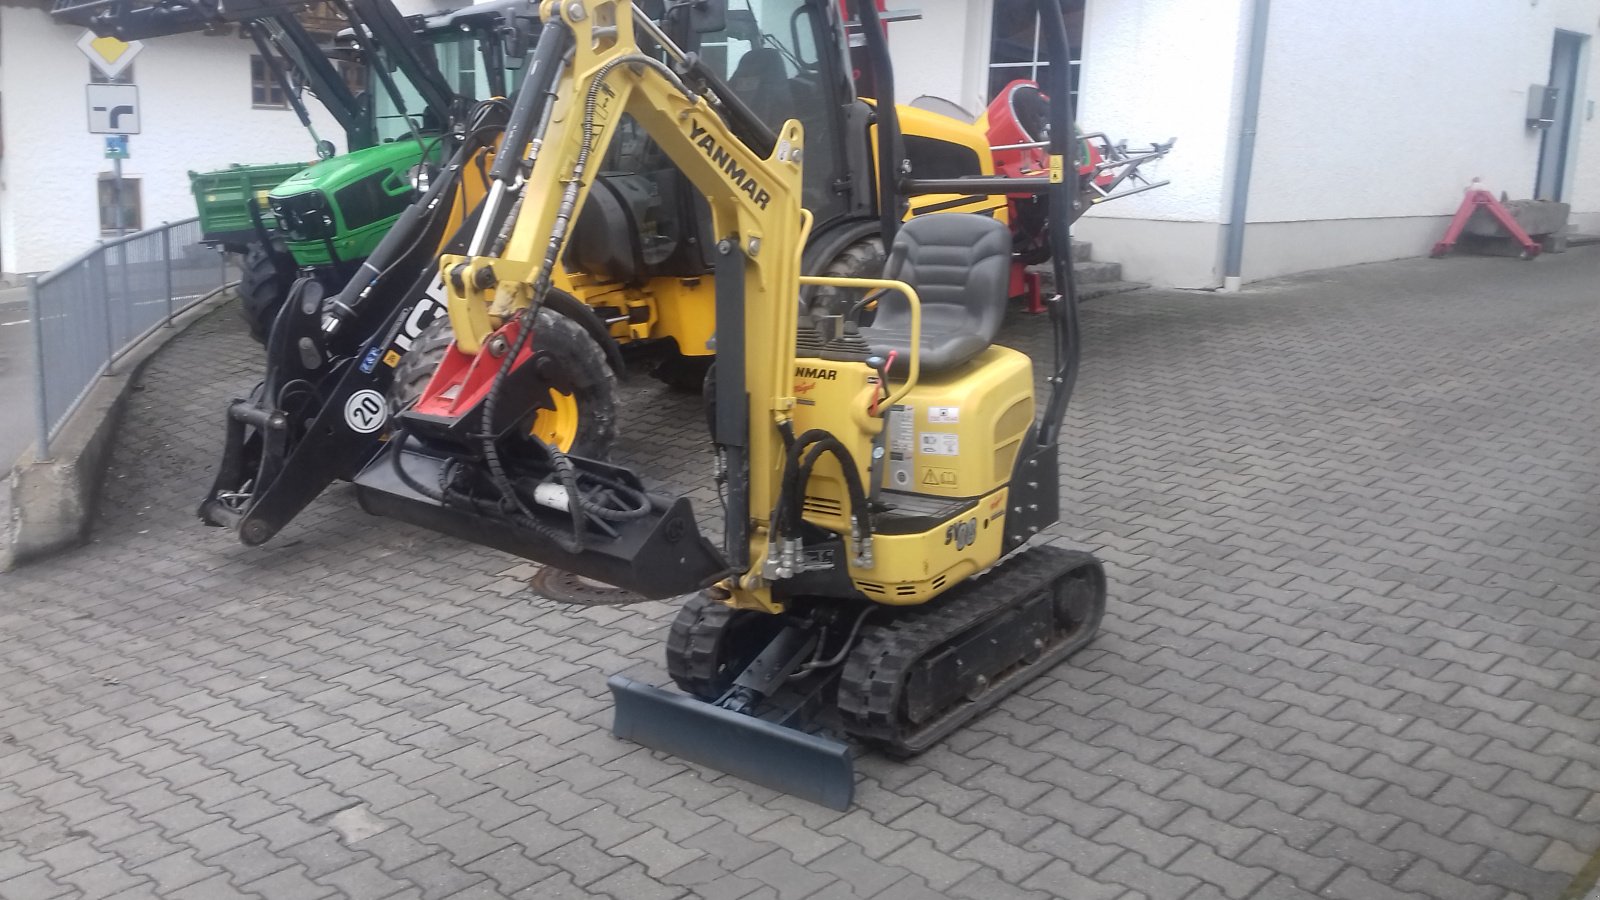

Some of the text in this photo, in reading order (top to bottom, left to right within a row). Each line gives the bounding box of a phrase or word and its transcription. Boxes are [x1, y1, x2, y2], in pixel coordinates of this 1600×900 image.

[690, 118, 771, 210] YANMAR
[795, 366, 837, 380] NMAR
[353, 396, 380, 427] 20
